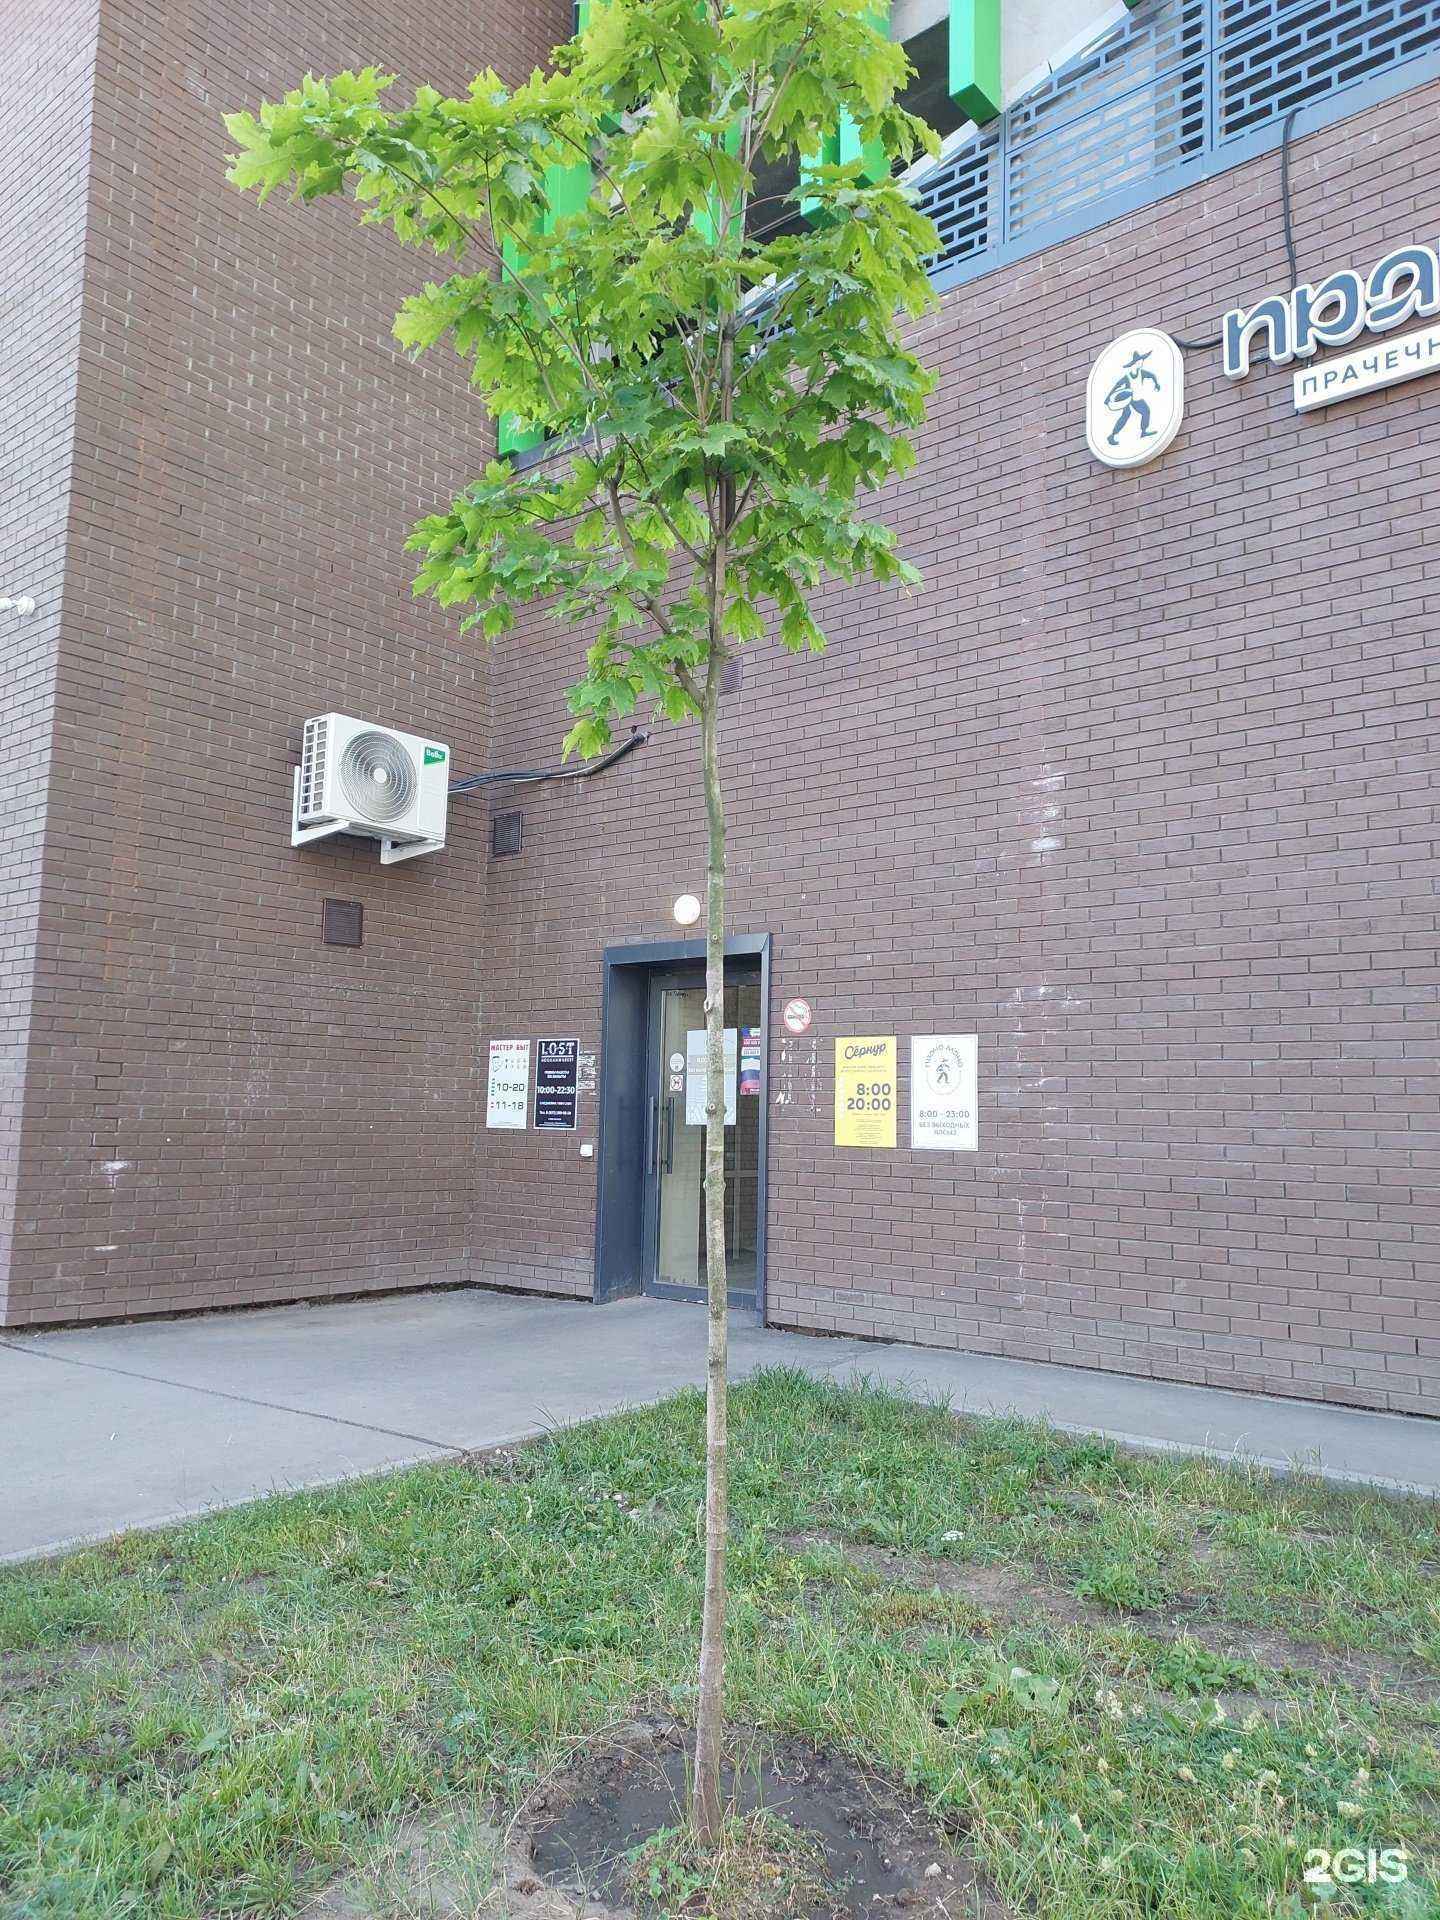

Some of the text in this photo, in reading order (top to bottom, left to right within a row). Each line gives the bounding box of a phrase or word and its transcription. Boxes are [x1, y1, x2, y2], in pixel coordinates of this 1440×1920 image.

[1222, 240, 1440, 380] пра
[541, 1042, 575, 1055] LOST
[496, 1083, 525, 1092] 10-20
[856, 1083, 891, 1096] 8:00
[496, 1101, 524, 1110] 11-18
[847, 1098, 891, 1111] 20:00
[919, 1110, 938, 1118] 8:00
